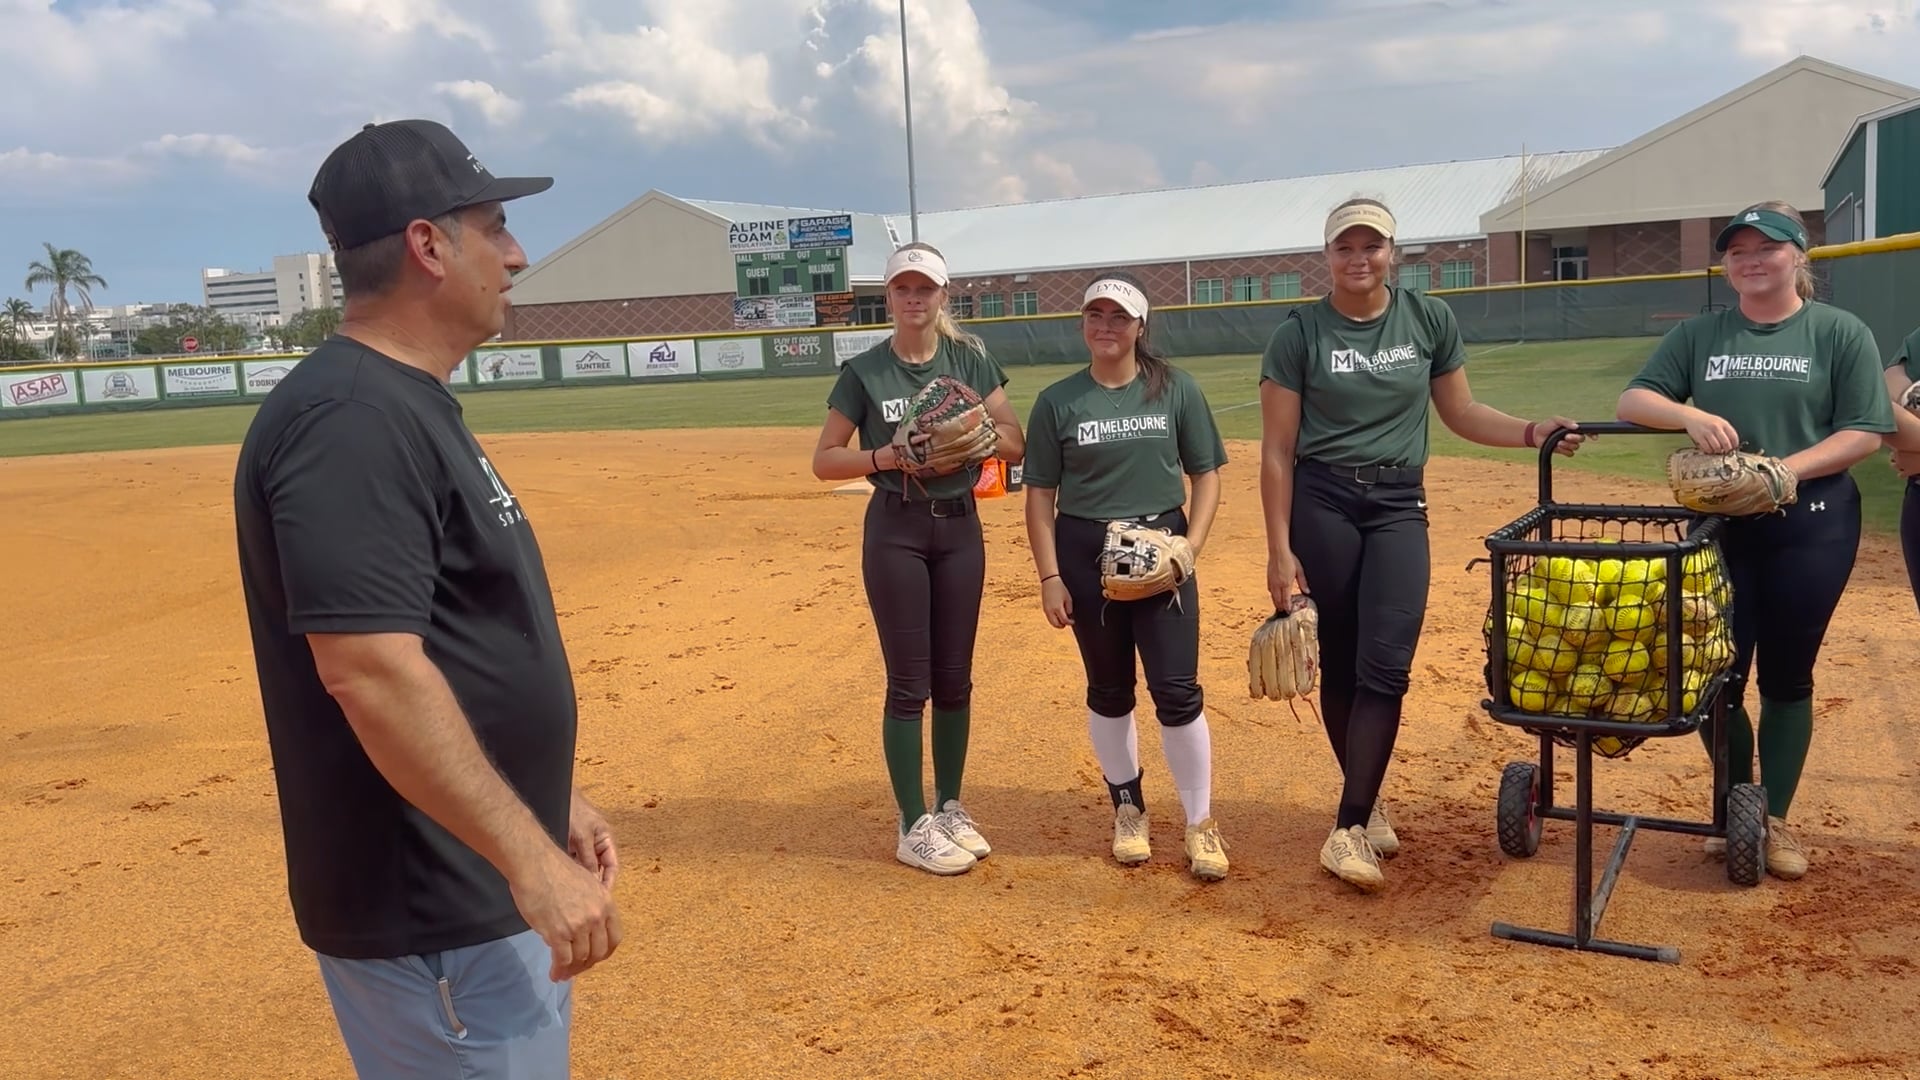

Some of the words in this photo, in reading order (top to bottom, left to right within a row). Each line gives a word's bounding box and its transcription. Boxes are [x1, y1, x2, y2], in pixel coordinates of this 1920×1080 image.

[730, 220, 785, 233] ALPINE
[800, 216, 849, 227] GARAGE
[729, 232, 772, 244] FOAM
[729, 241, 773, 249] INSULATION
[736, 253, 753, 263] BALL
[762, 251, 786, 261] STRIKE
[796, 250, 810, 259] OUT
[745, 267, 770, 278] GUEST
[1096, 283, 1132, 297] LYNN
[774, 342, 822, 357] SPORTS
[1354, 345, 1416, 367] MLBOURNE
[167, 365, 232, 377] MELBOURNE
[575, 362, 612, 370] SUNTREE
[1728, 357, 1809, 374] MELBOURNE
[16, 376, 61, 399] ASAP
[1100, 416, 1167, 434] MELBOURNE
[1101, 431, 1143, 440] SOFTBALL
